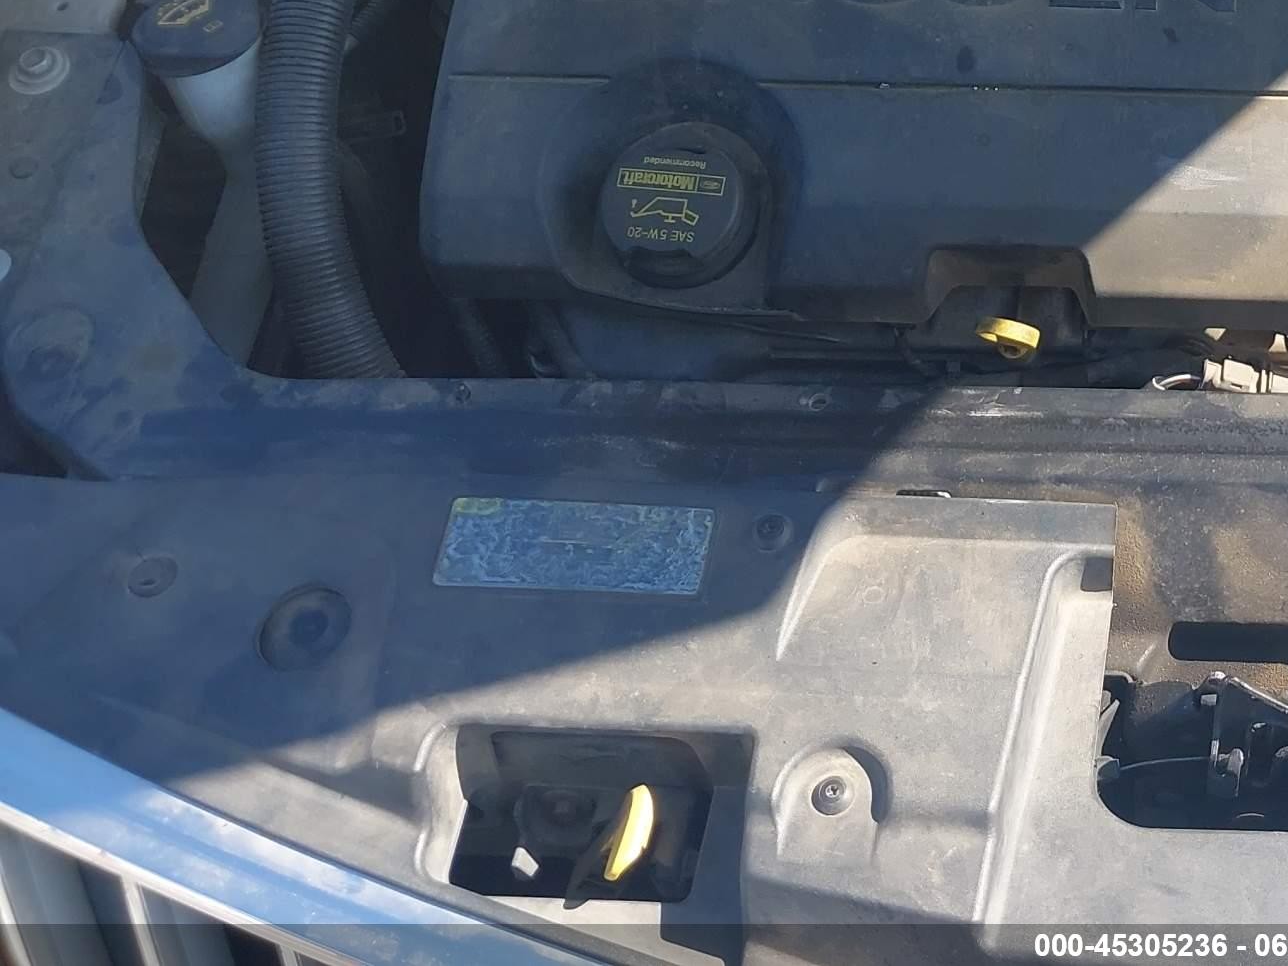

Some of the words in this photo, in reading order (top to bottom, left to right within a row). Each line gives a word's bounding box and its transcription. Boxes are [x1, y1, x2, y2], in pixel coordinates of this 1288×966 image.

[643, 156, 707, 170] Recommended
[623, 170, 697, 190] Motorcraft
[626, 226, 668, 240] 5W-20
[670, 230, 695, 243] SAE
